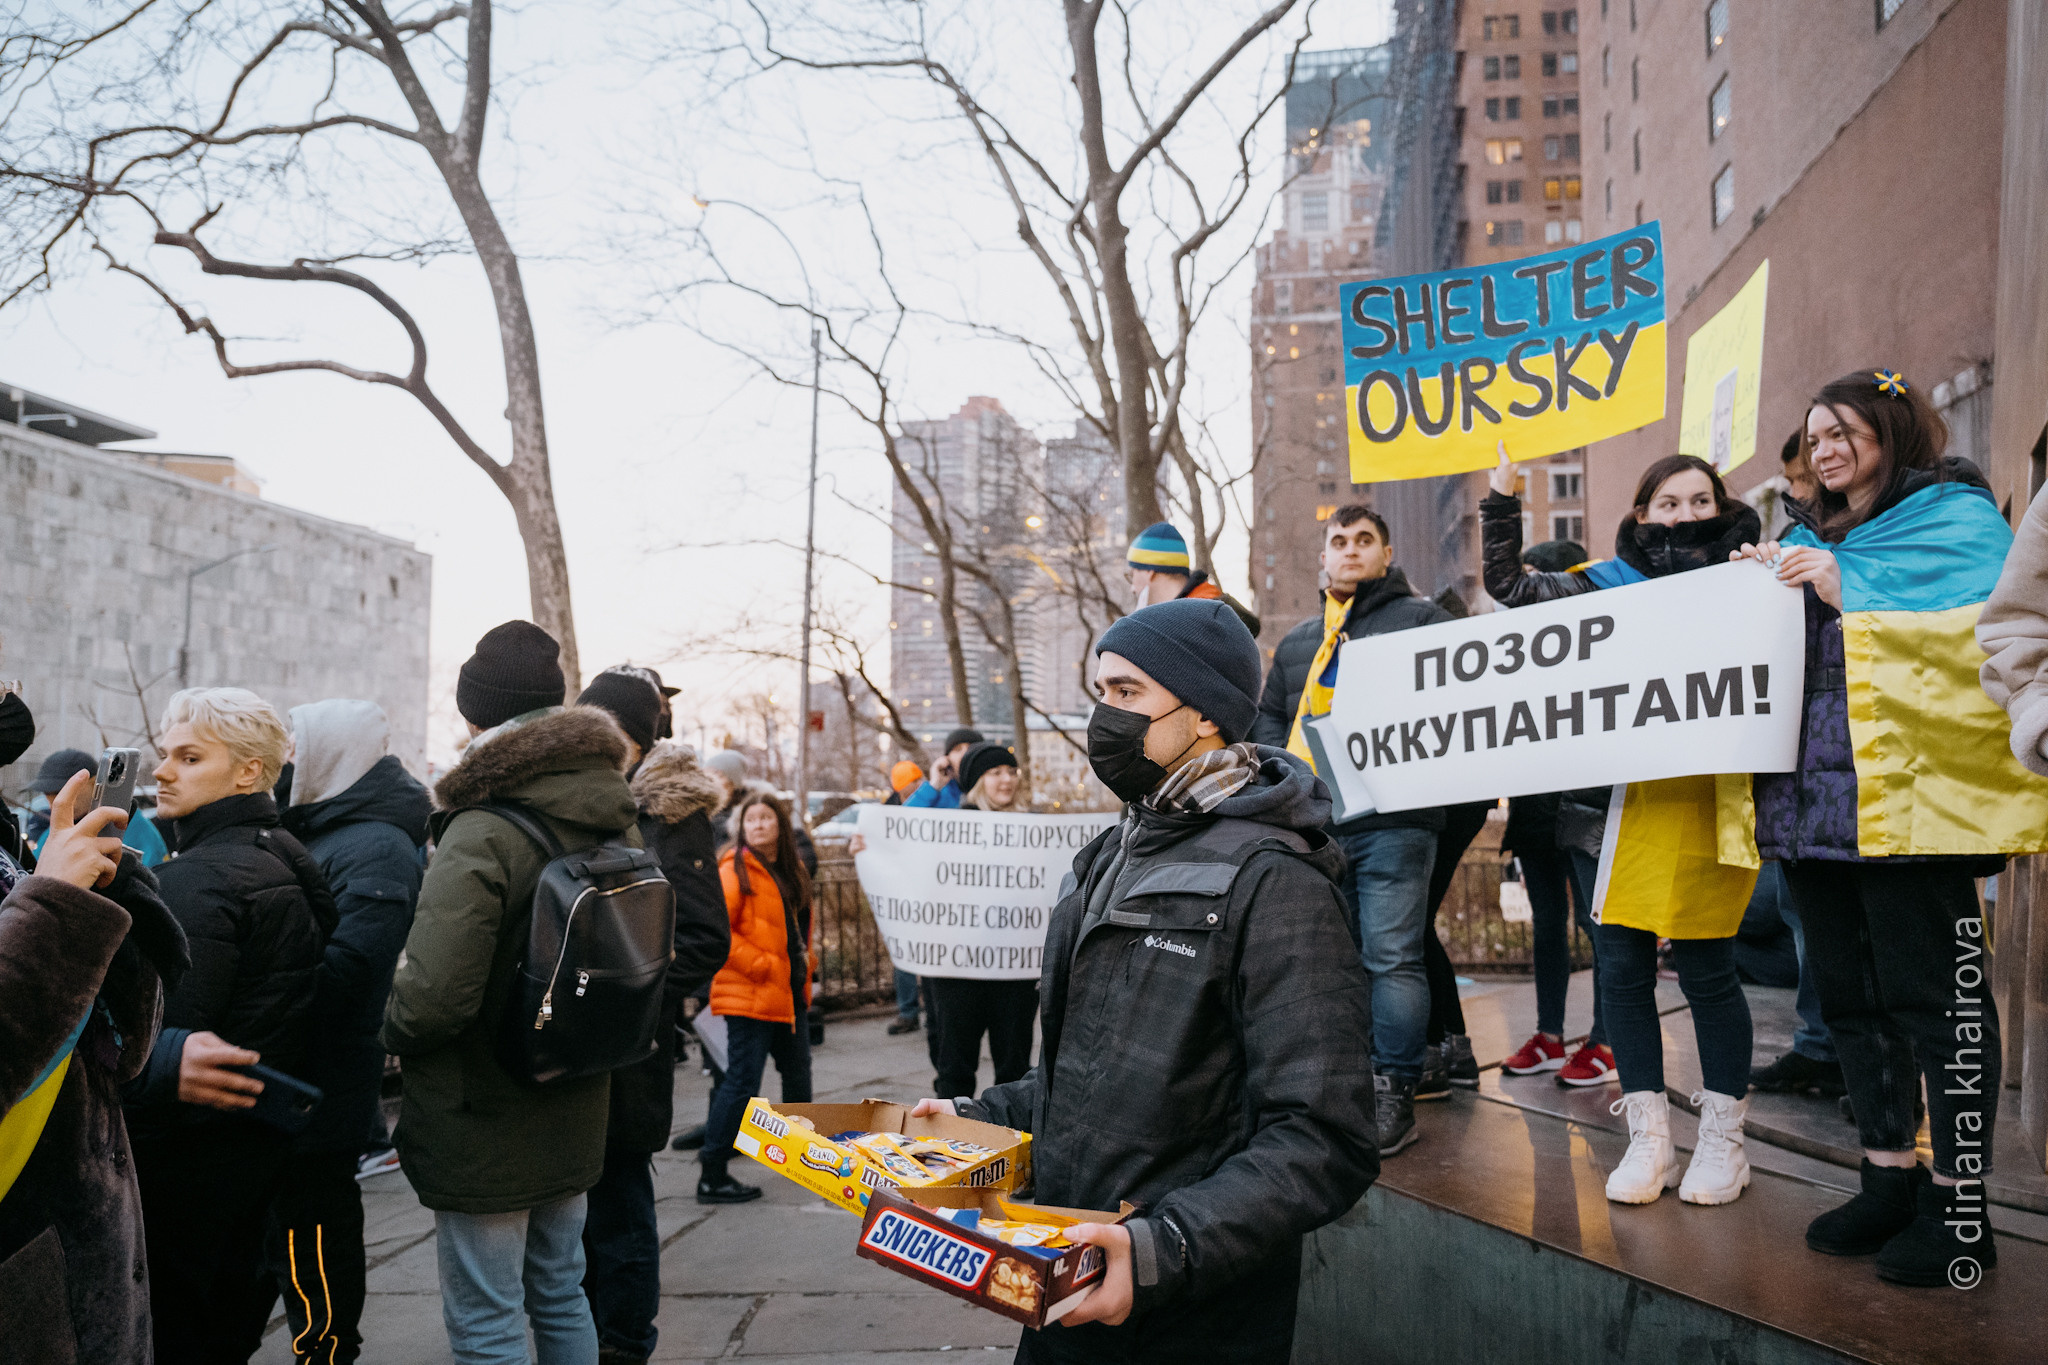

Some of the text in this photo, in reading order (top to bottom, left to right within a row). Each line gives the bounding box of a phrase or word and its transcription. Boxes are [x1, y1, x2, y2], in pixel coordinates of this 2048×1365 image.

[1351, 236, 1658, 359] SHELTER
[1414, 614, 1615, 693] ПОЗОР
[1346, 663, 1772, 772] ОККУПАНТАМ!
[885, 816, 988, 849] РОССИЯНЕ,
[936, 861, 1046, 889] ОЧНИТЕСЬ!
[888, 897, 981, 928] ПОЗОРЬТЕ
[985, 905, 1042, 930] СВОЮ
[907, 940, 947, 967] МИР
[1153, 937, 1197, 958] Columbia
[808, 1146, 836, 1164] PEANUT
[870, 1214, 986, 1282] SNICKERS
